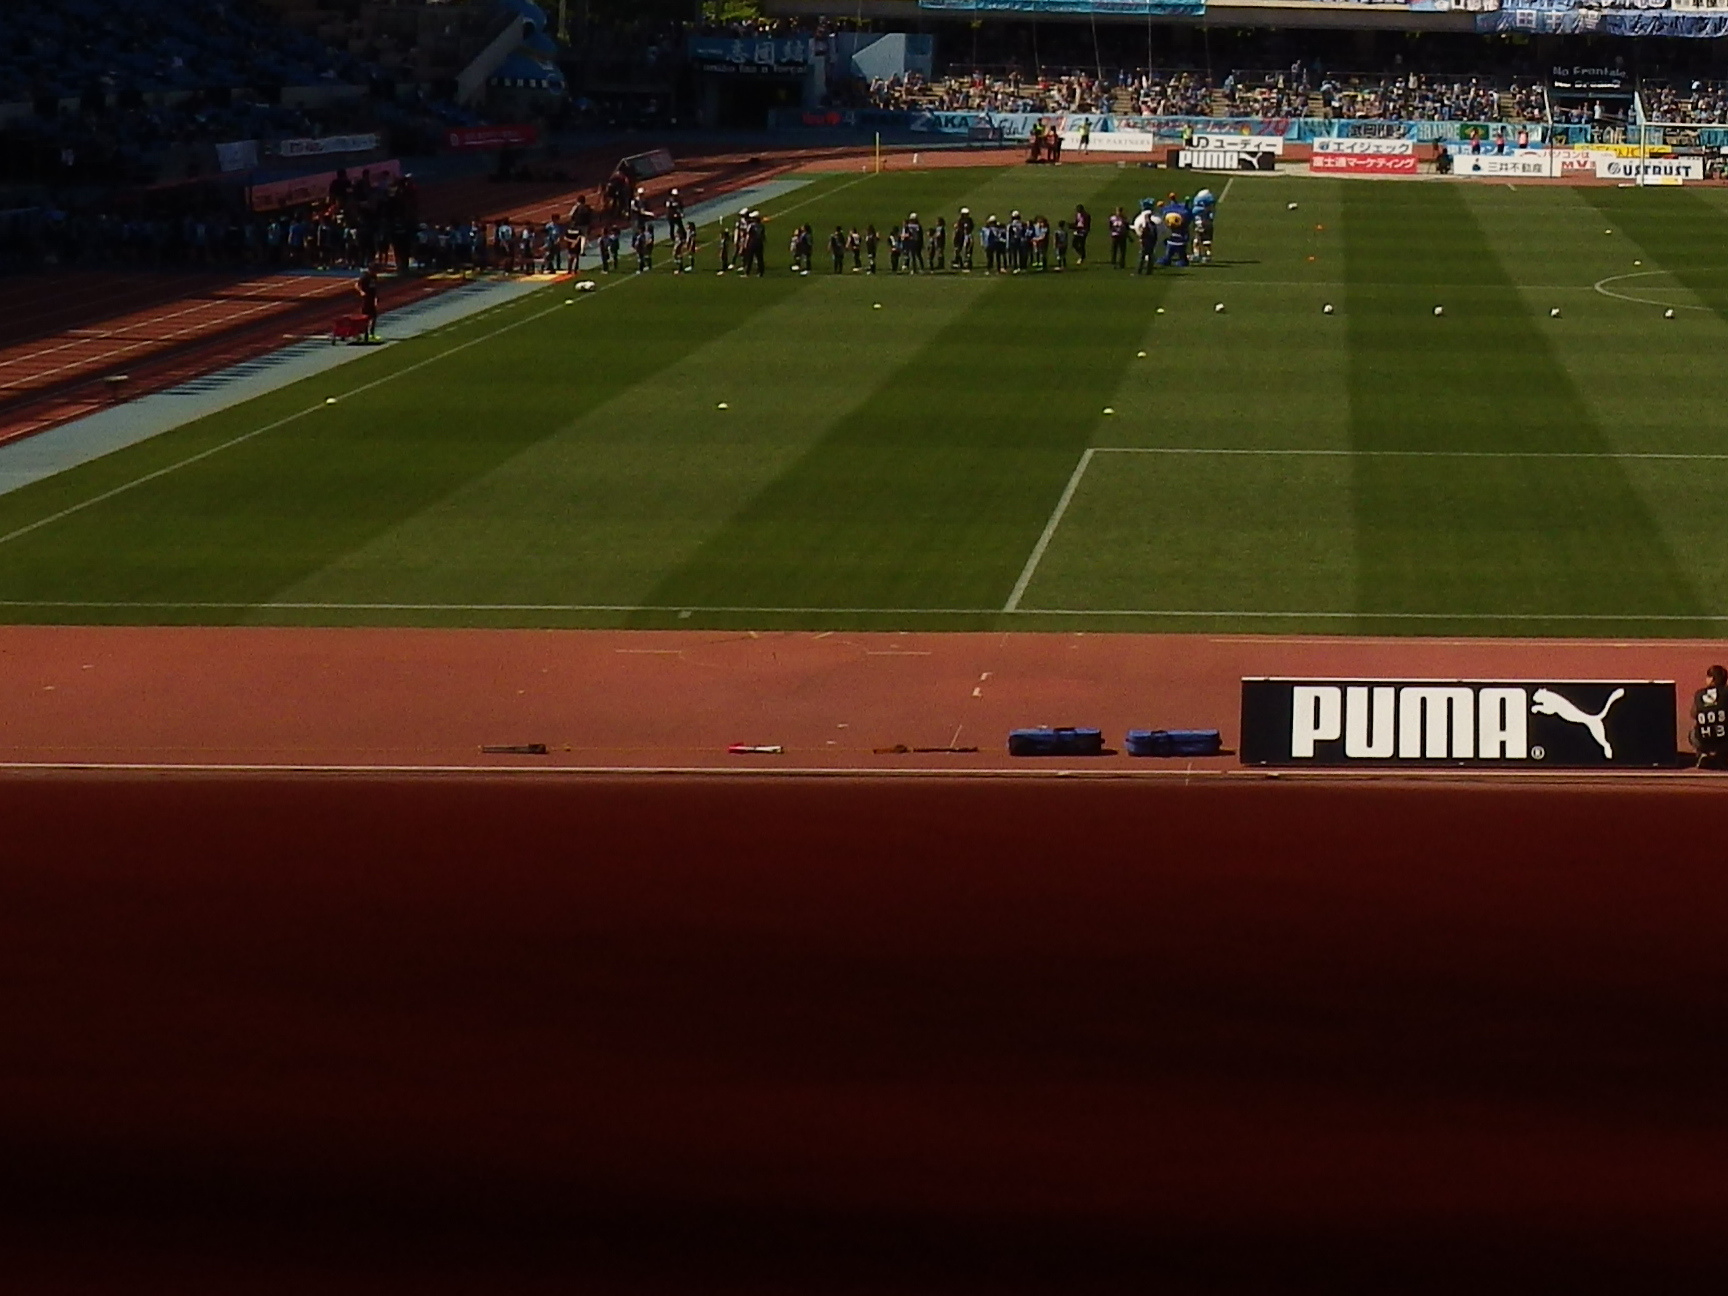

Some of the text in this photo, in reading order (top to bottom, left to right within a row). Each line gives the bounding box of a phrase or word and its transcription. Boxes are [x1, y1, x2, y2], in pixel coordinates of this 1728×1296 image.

[1214, 136, 1277, 150] ユーディー
[1333, 142, 1410, 154] エイジェック
[1179, 151, 1239, 169] PUMA
[1312, 156, 1416, 169] 富士通マーケティング
[1489, 161, 1543, 173] 三井不動産
[1291, 686, 1528, 759] PUMA
